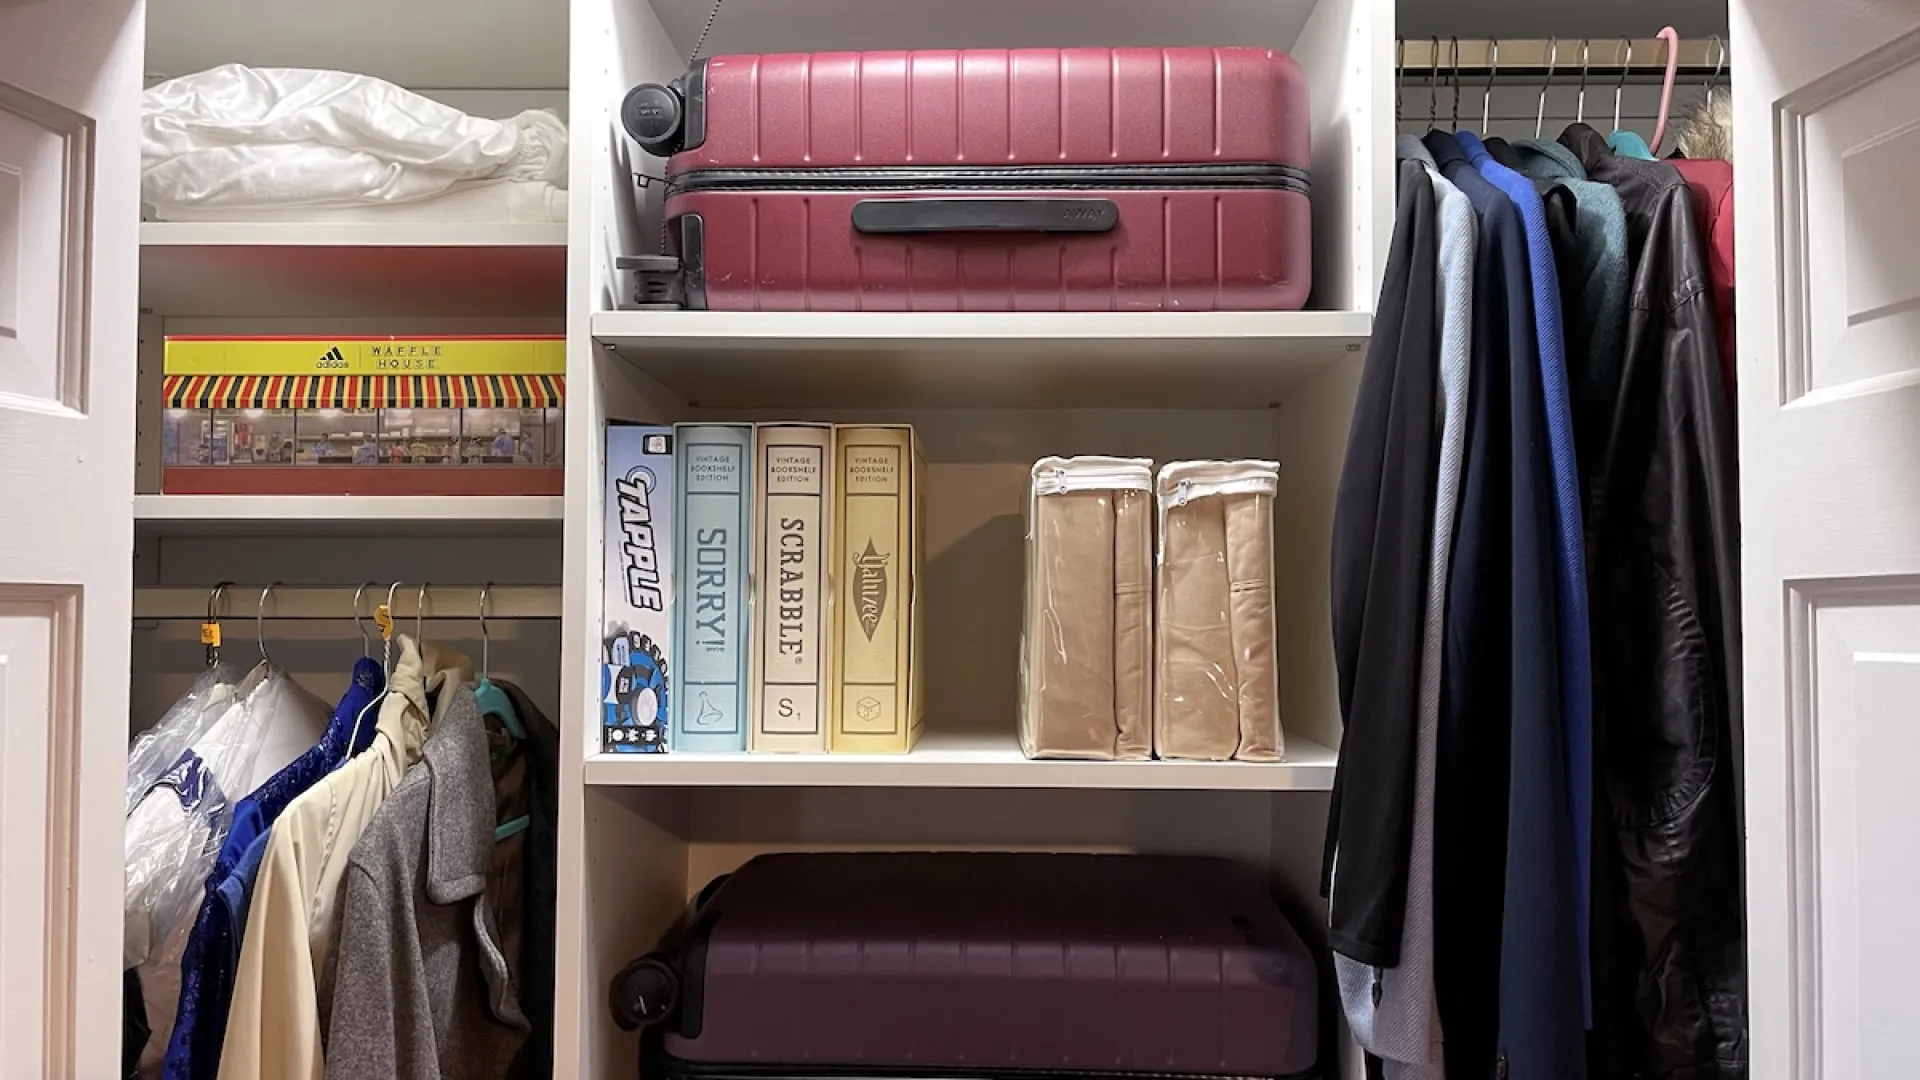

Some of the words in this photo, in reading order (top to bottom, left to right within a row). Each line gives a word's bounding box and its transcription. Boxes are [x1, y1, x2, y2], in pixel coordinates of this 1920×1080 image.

[1063, 208, 1105, 220] AWAY
[372, 345, 442, 356] WAFFLE
[316, 360, 349, 369] adidas
[378, 358, 436, 369] HOUSE
[695, 455, 730, 463] VINTAGE
[776, 457, 811, 465] VINTAGE
[854, 457, 889, 465] VINTAGE
[690, 465, 736, 473] BOOKSHELF
[771, 466, 816, 474] BOOKSHELF
[849, 466, 895, 474] BOOKSHELF
[695, 474, 729, 482] EDITION
[776, 475, 810, 483] EDITION
[855, 475, 888, 483] EDITION
[616, 478, 663, 611] TAPPLE
[696, 528, 727, 646] SORRY!
